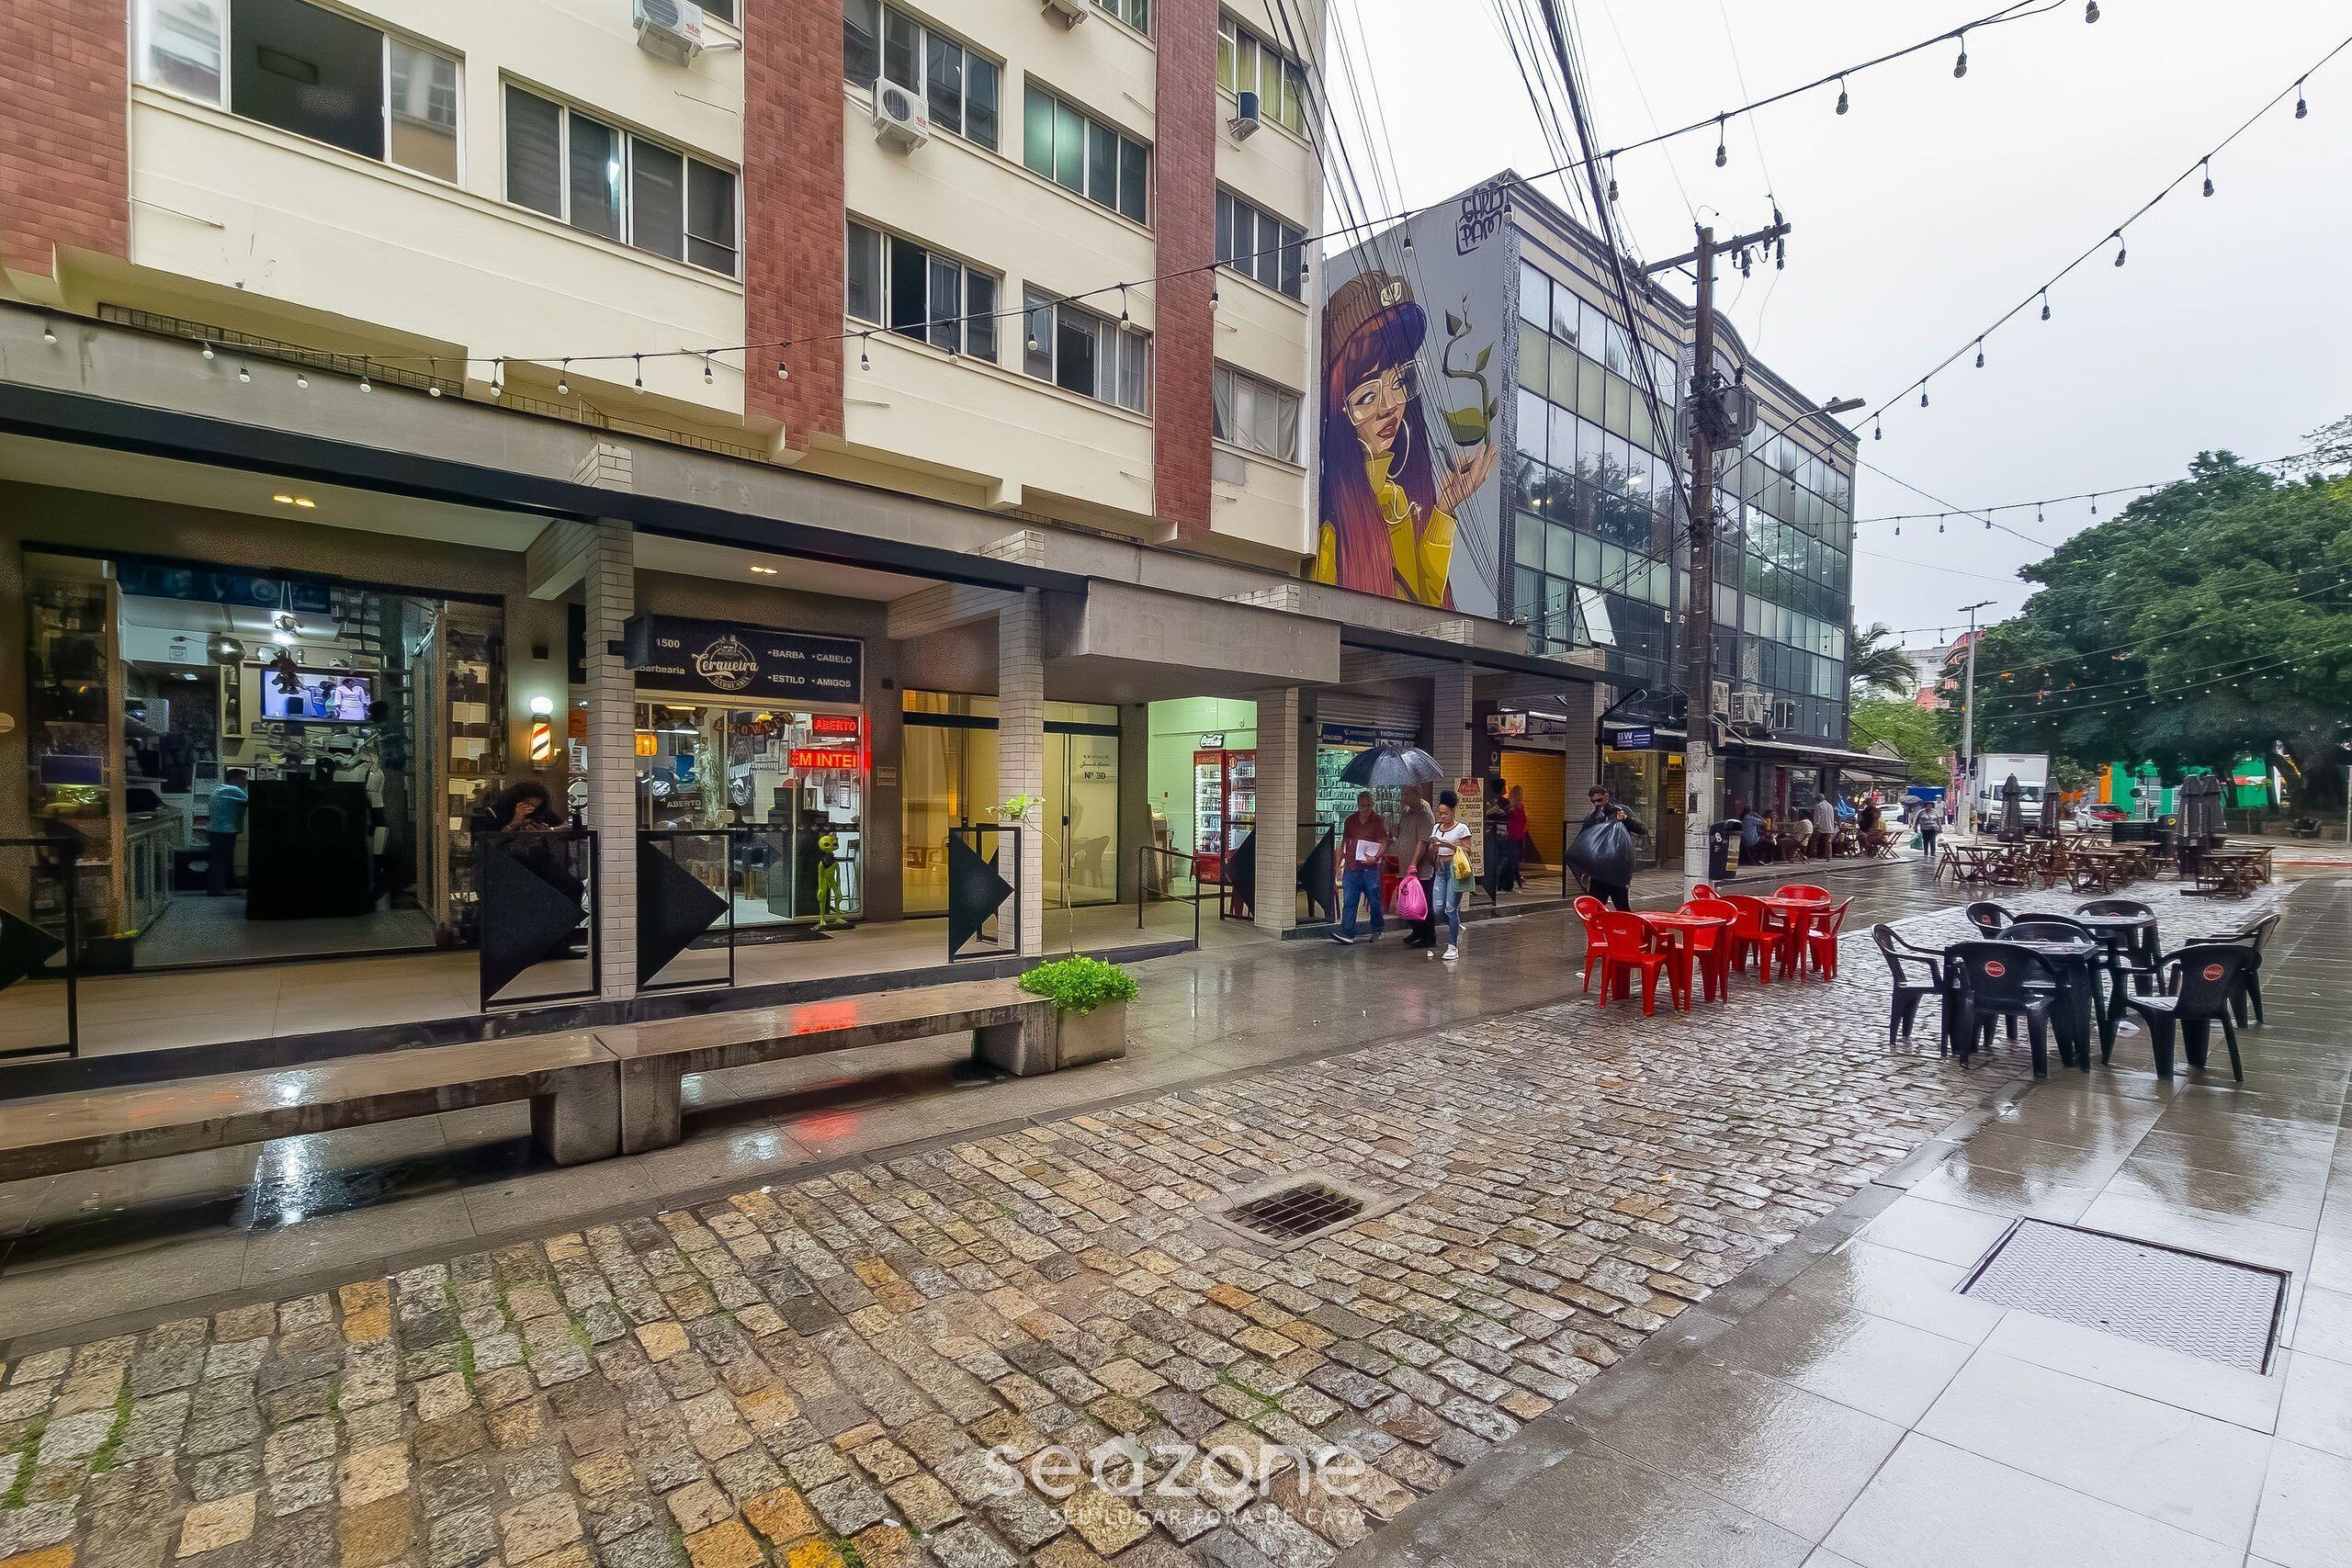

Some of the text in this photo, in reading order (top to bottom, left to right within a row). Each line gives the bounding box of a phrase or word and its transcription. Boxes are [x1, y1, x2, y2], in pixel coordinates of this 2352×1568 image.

[773, 649, 853, 664] BARBA CABELO
[773, 674, 853, 688] ESTILO AMIGOS
[814, 718, 858, 731] ABERTO
[1617, 732, 1633, 740] BW
[1096, 772, 1106, 780] 30
[666, 799, 702, 808] ABERTO
